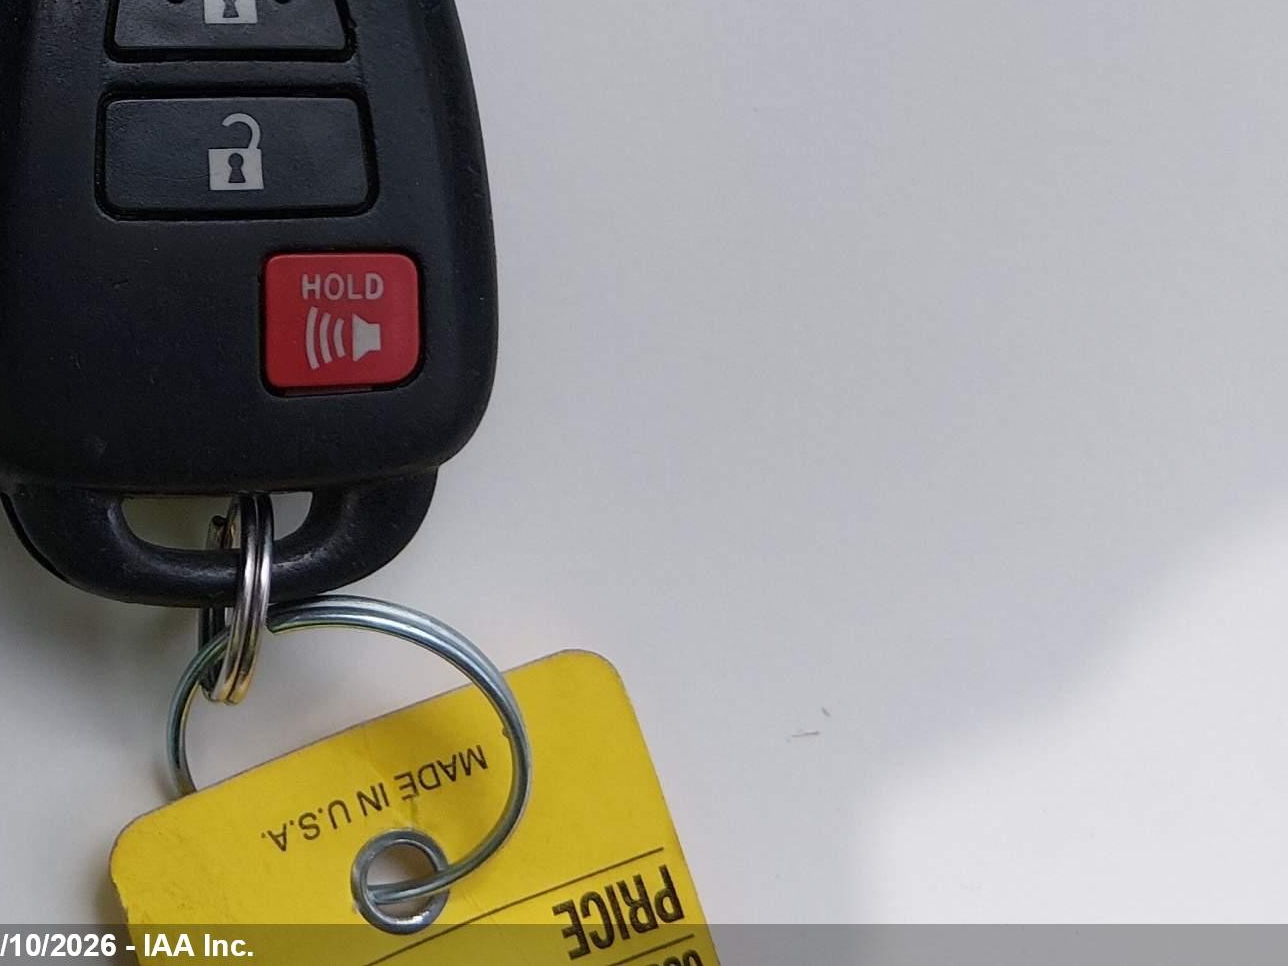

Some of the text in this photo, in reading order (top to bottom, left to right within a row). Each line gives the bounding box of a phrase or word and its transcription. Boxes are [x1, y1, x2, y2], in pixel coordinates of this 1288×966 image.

[301, 273, 384, 300] HOLD
[260, 745, 489, 852] MADE IN U.S.A.
[552, 865, 685, 960] PRICE
